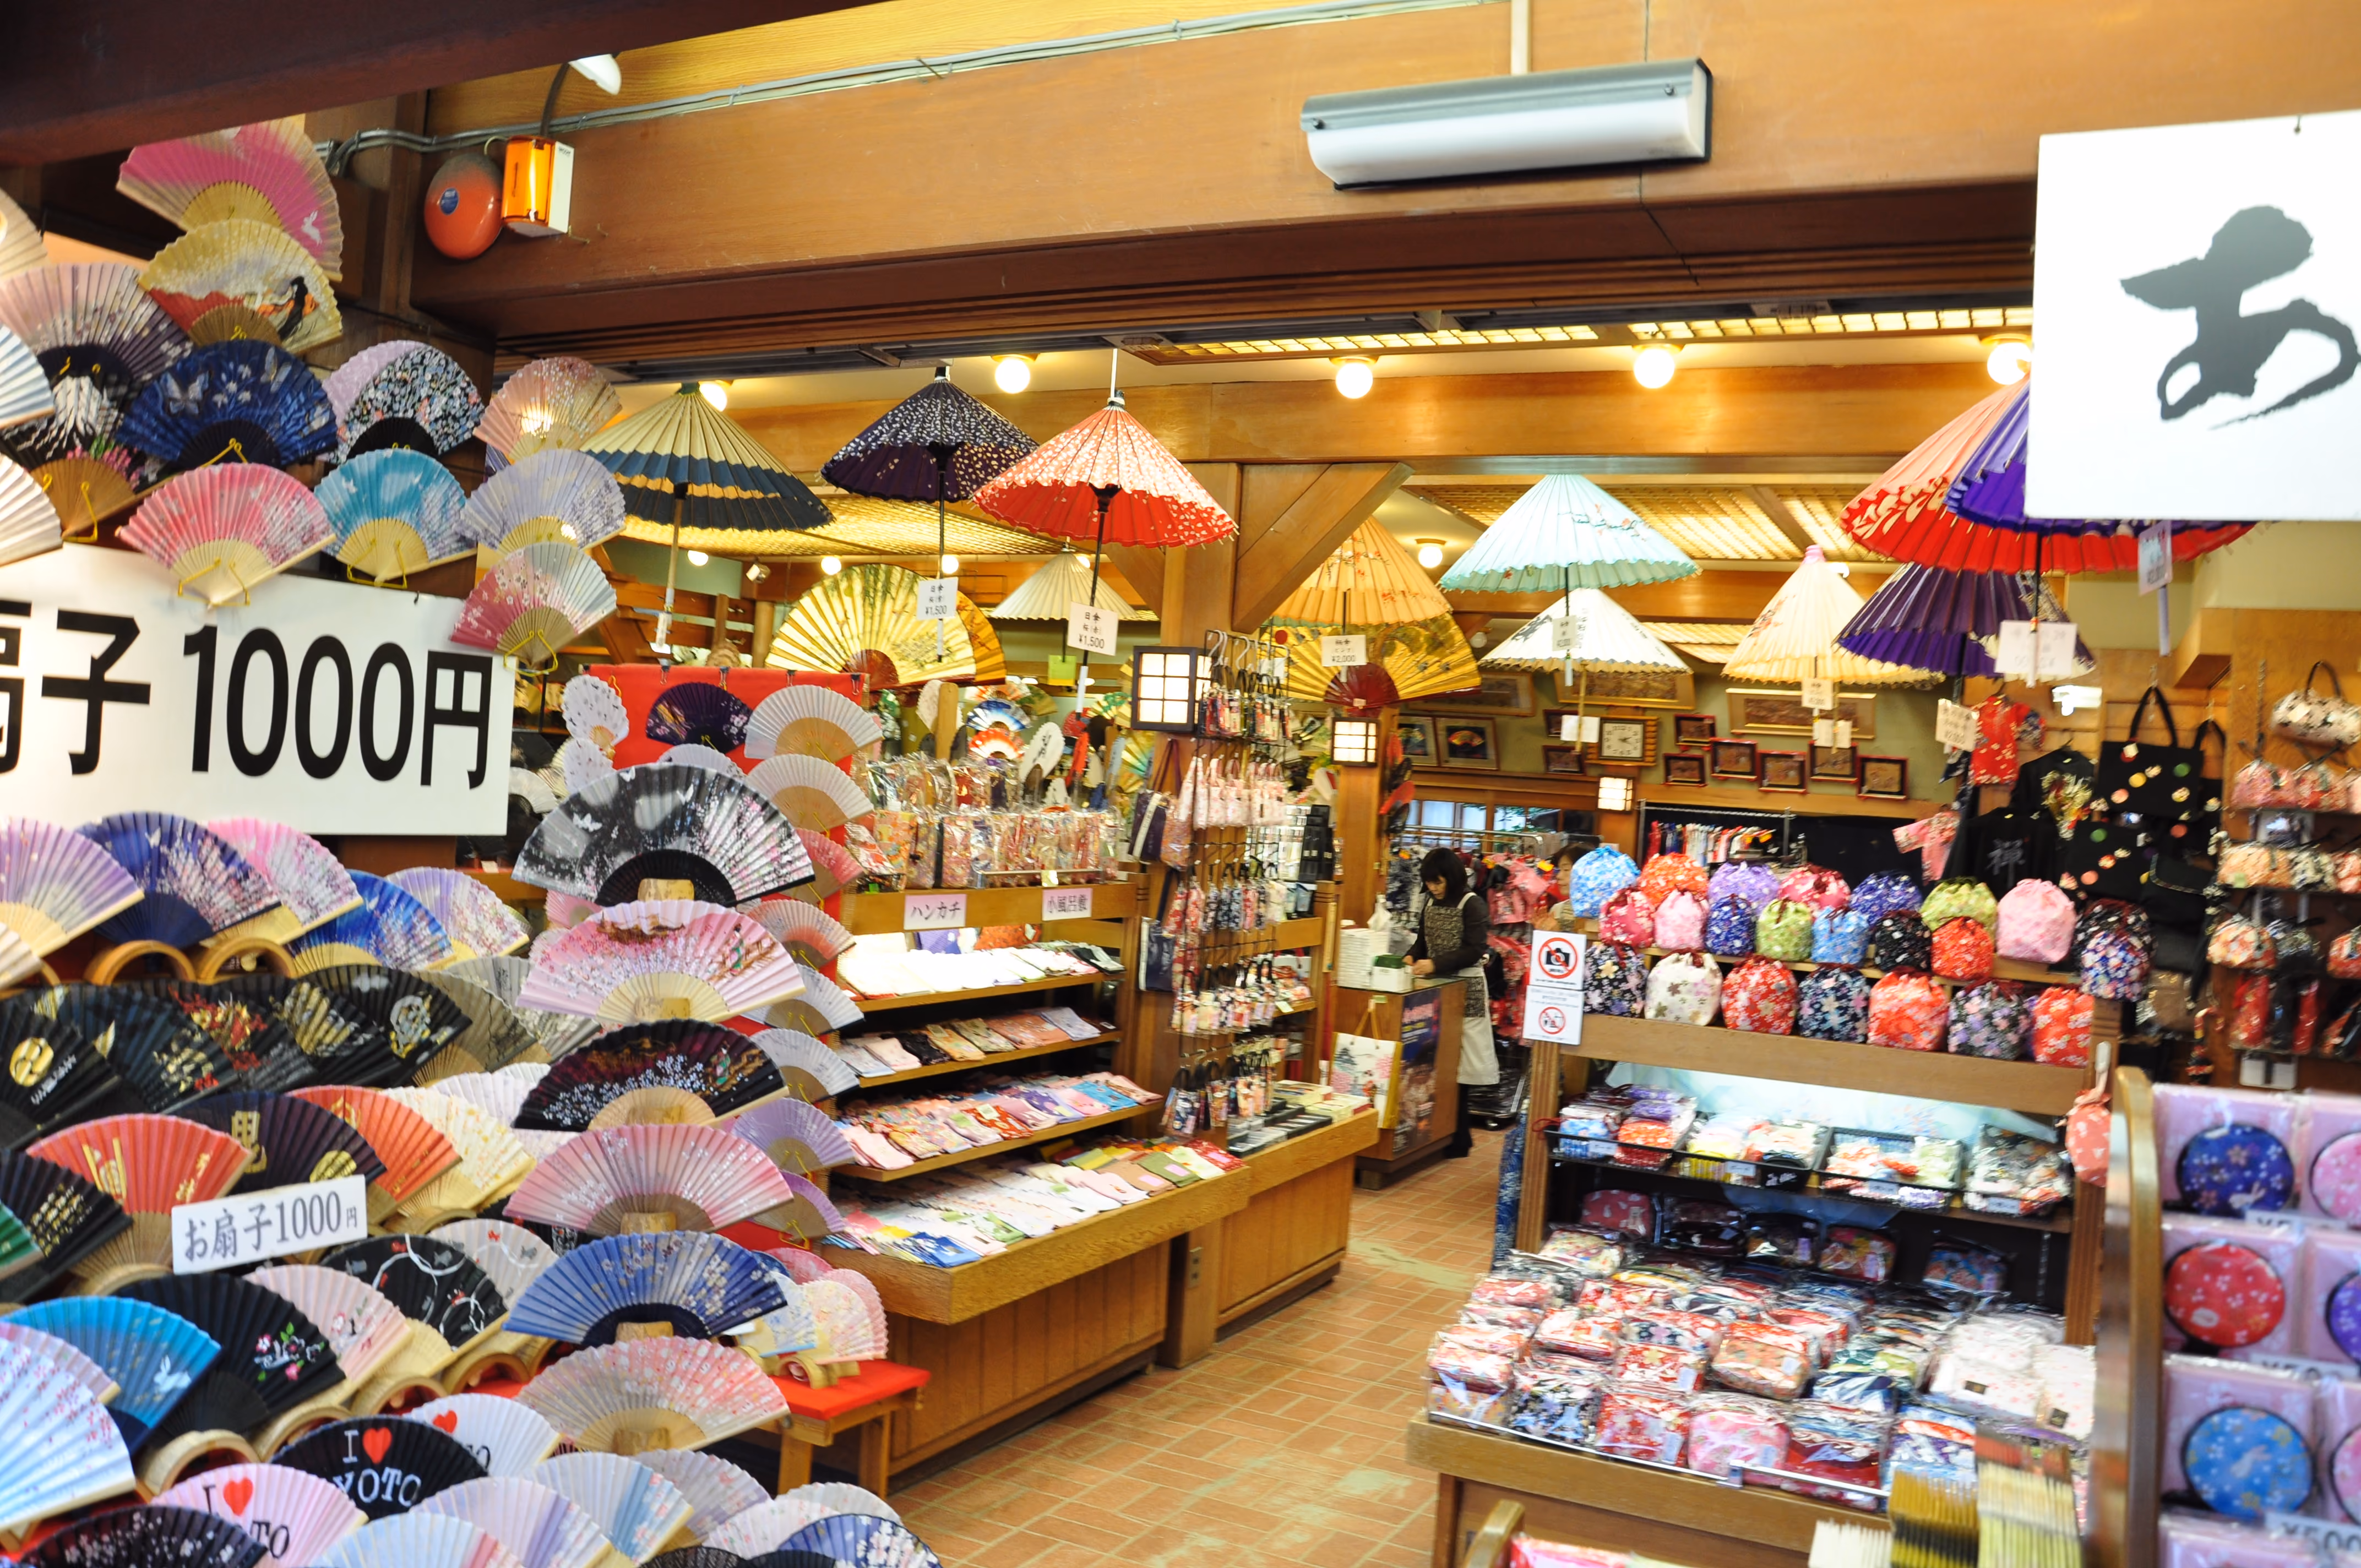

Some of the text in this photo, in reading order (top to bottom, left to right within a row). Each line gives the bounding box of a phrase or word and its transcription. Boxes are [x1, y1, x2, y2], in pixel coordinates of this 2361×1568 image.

[1079, 634, 1105, 649] ¥1,500
[183, 624, 493, 790] 1000円
[911, 901, 961, 921] ハンカチ
[342, 1429, 360, 1463] I
[333, 1466, 421, 1507] YOTO
